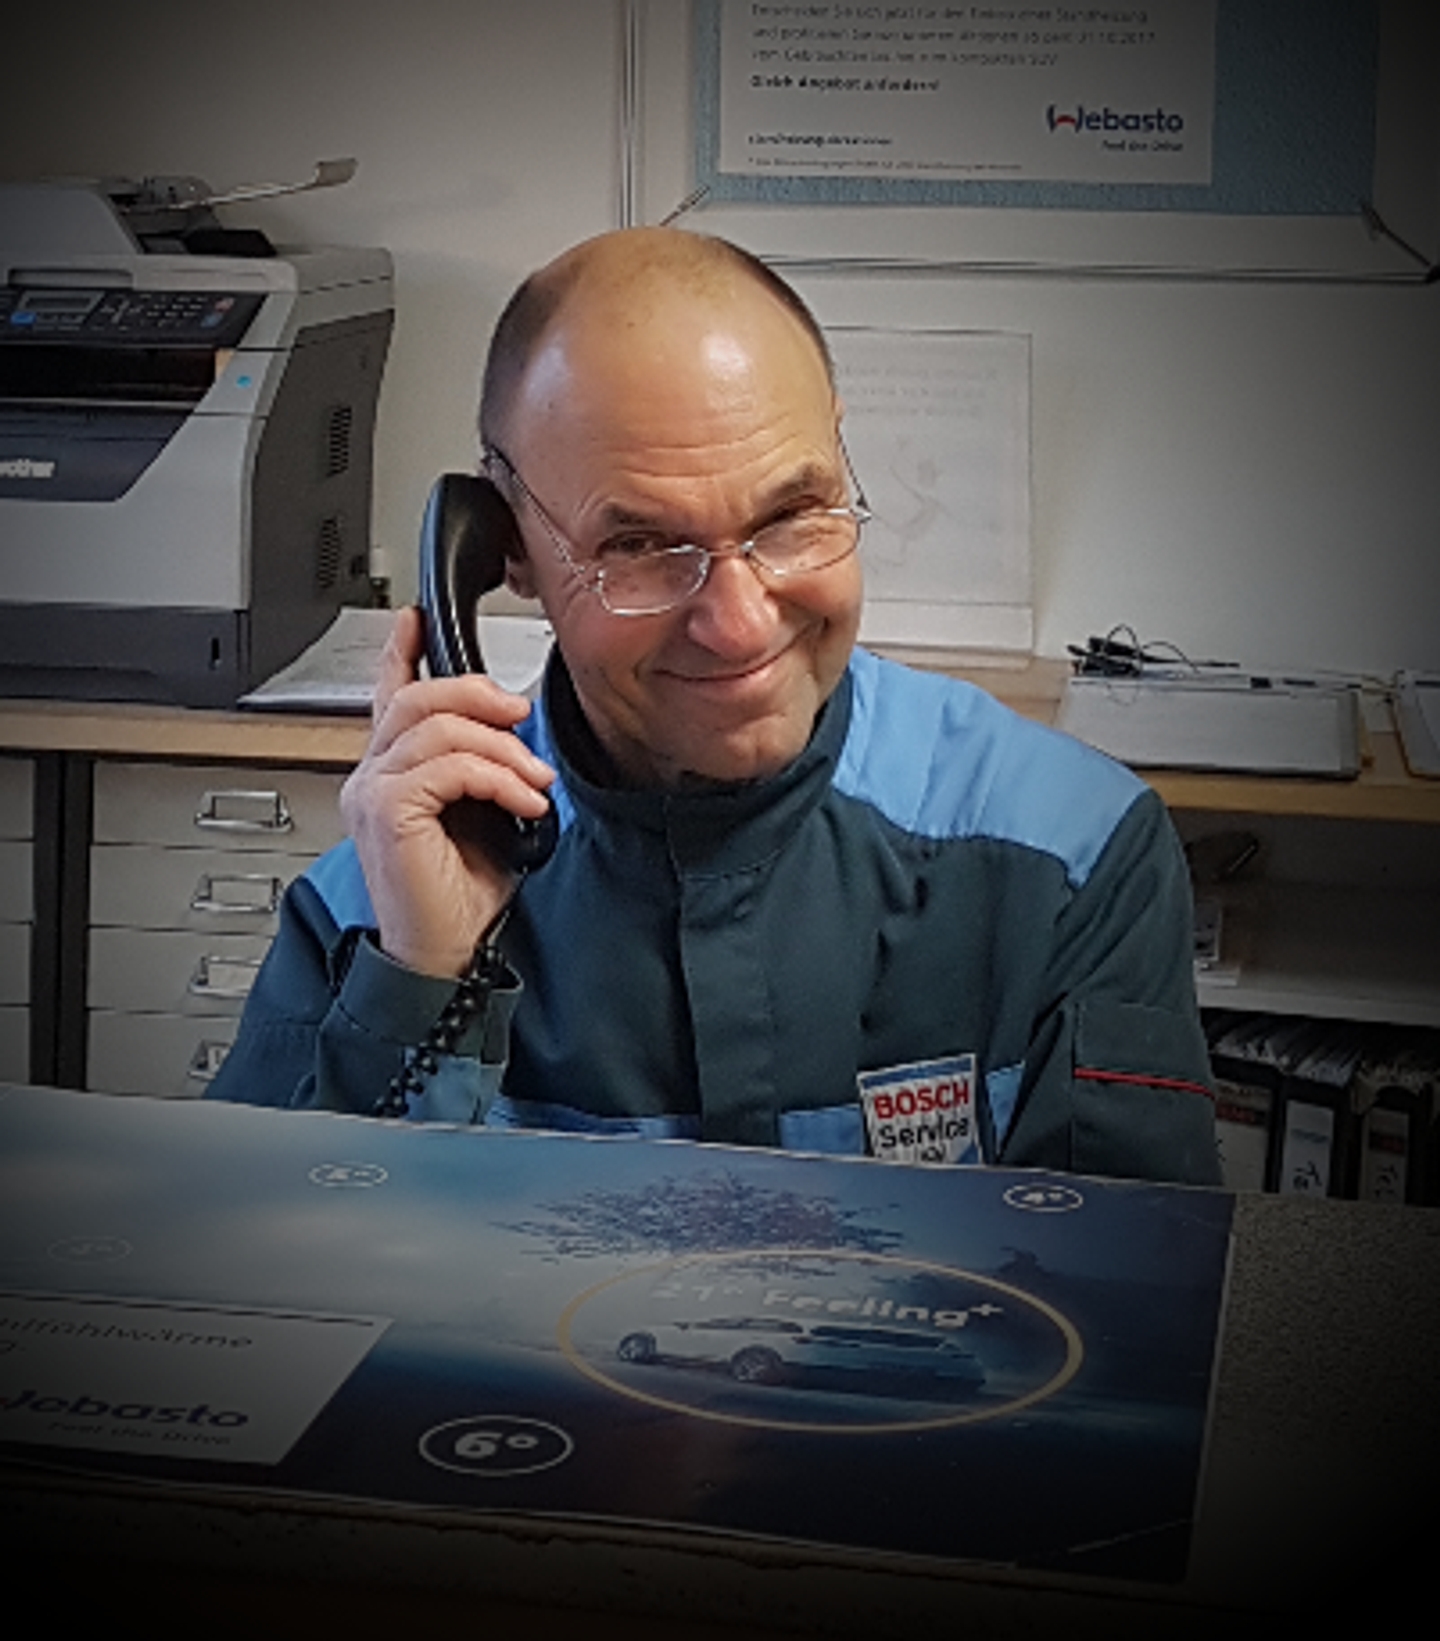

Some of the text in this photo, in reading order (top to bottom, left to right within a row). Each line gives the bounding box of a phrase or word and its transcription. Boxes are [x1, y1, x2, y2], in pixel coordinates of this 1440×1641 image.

[1046, 104, 1184, 134] Webasto
[873, 1081, 969, 1119] BOSCH
[879, 1115, 969, 1148] Service
